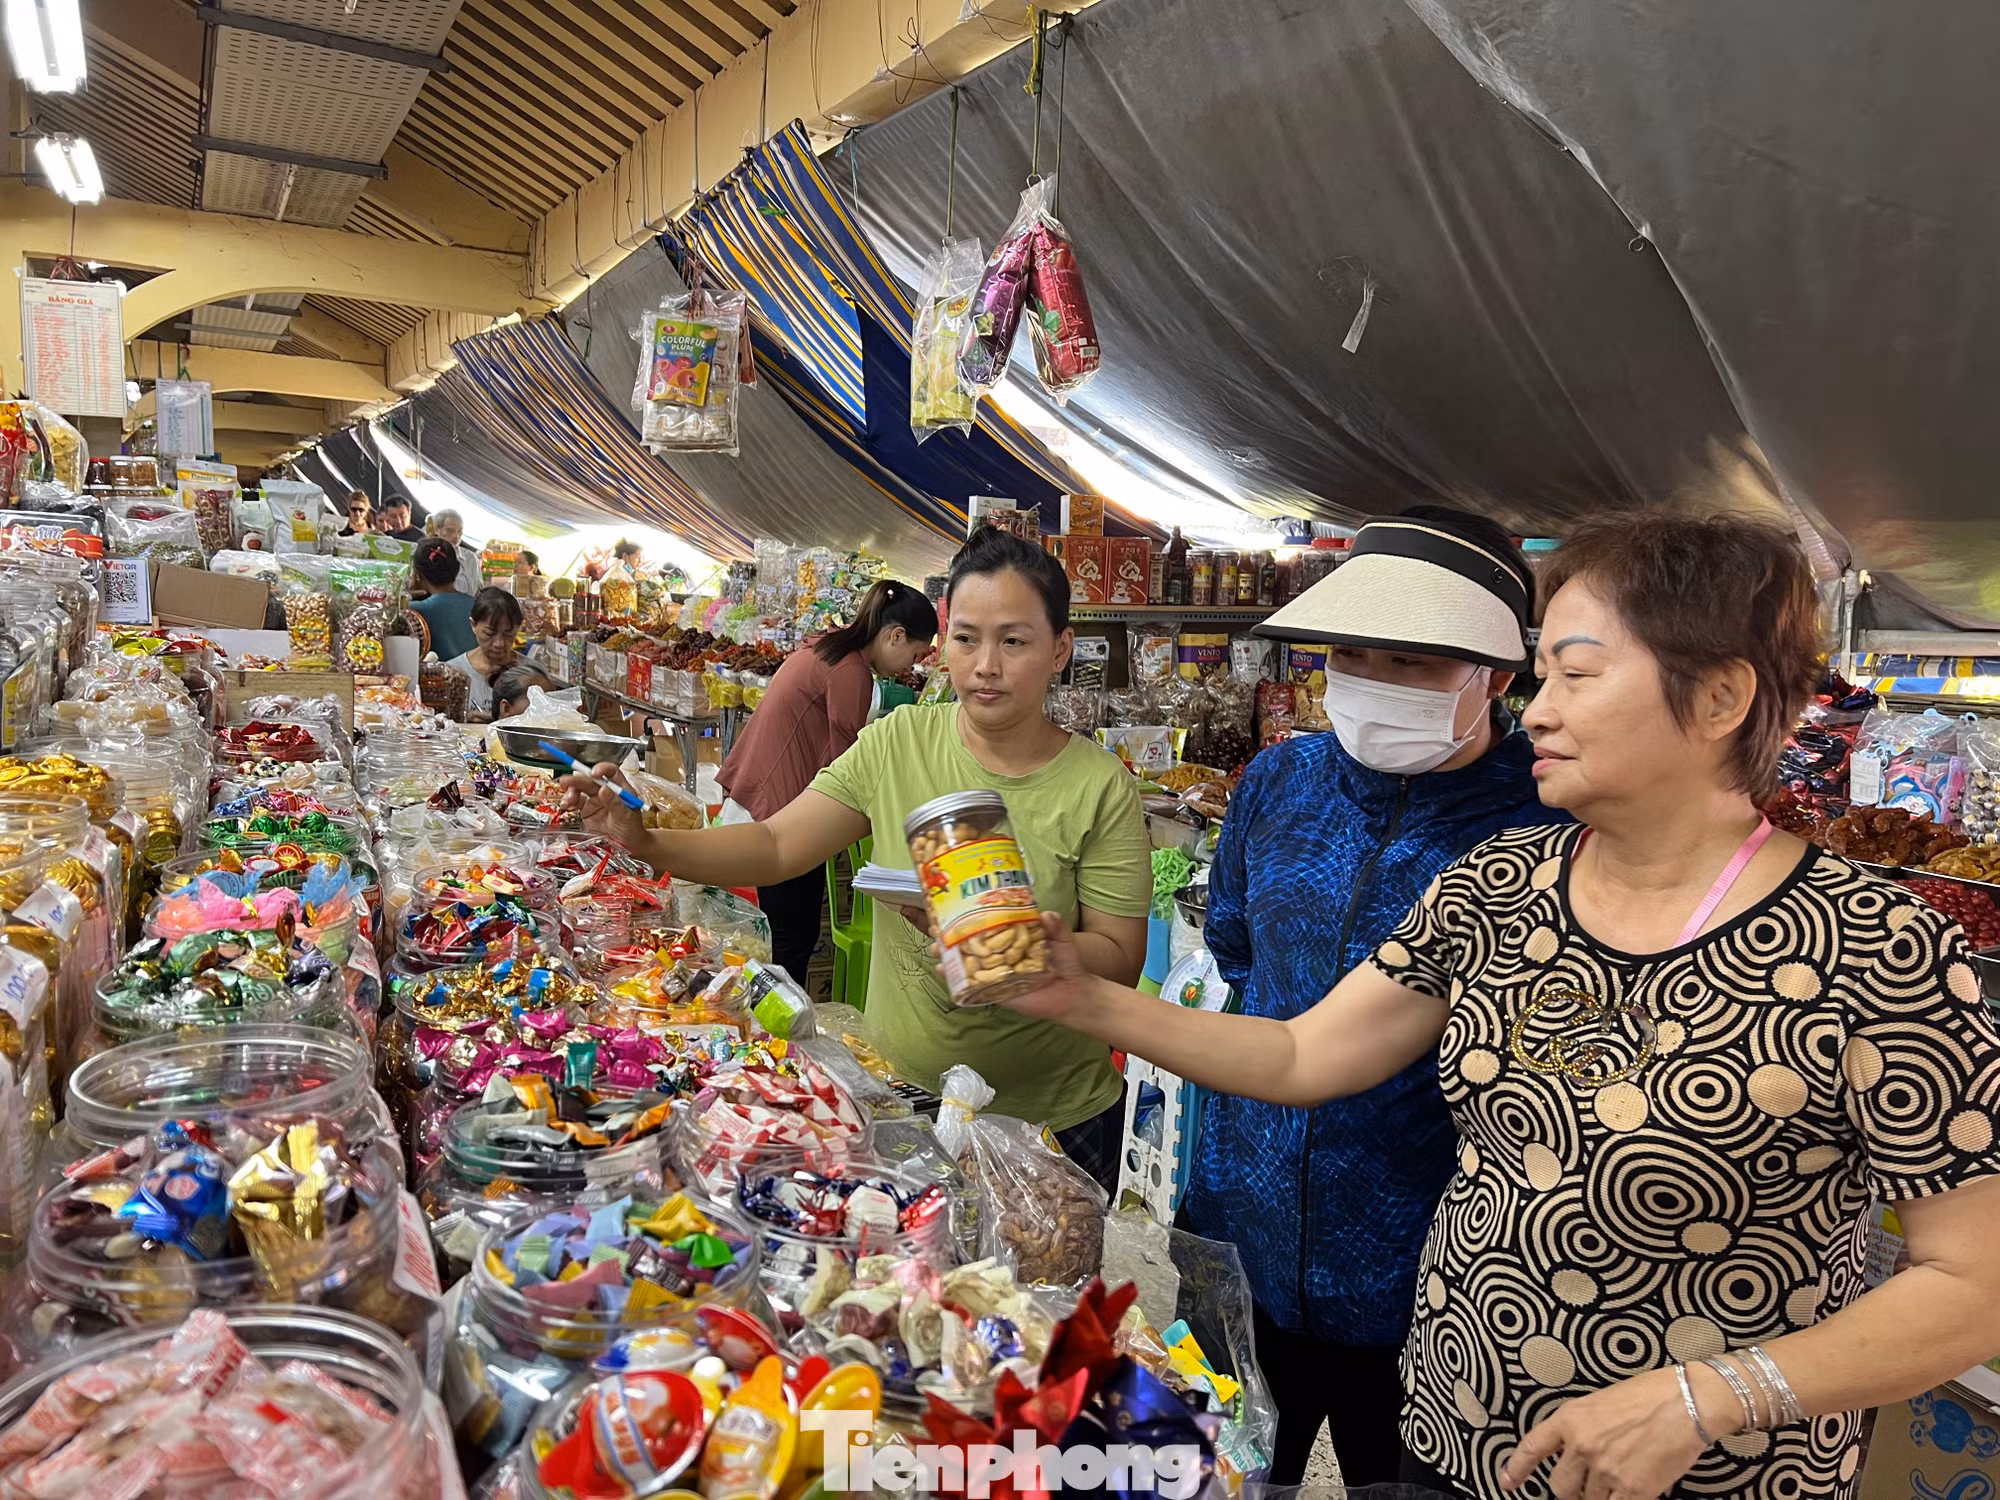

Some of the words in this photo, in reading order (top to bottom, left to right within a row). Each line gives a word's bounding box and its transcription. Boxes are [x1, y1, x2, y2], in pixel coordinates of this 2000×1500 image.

[661, 335, 706, 348] COLORFUL
[671, 343, 694, 352] PLUM
[102, 560, 137, 570] VIETQR
[1198, 648, 1221, 657] VENTO
[1291, 653, 1313, 663] VENTO
